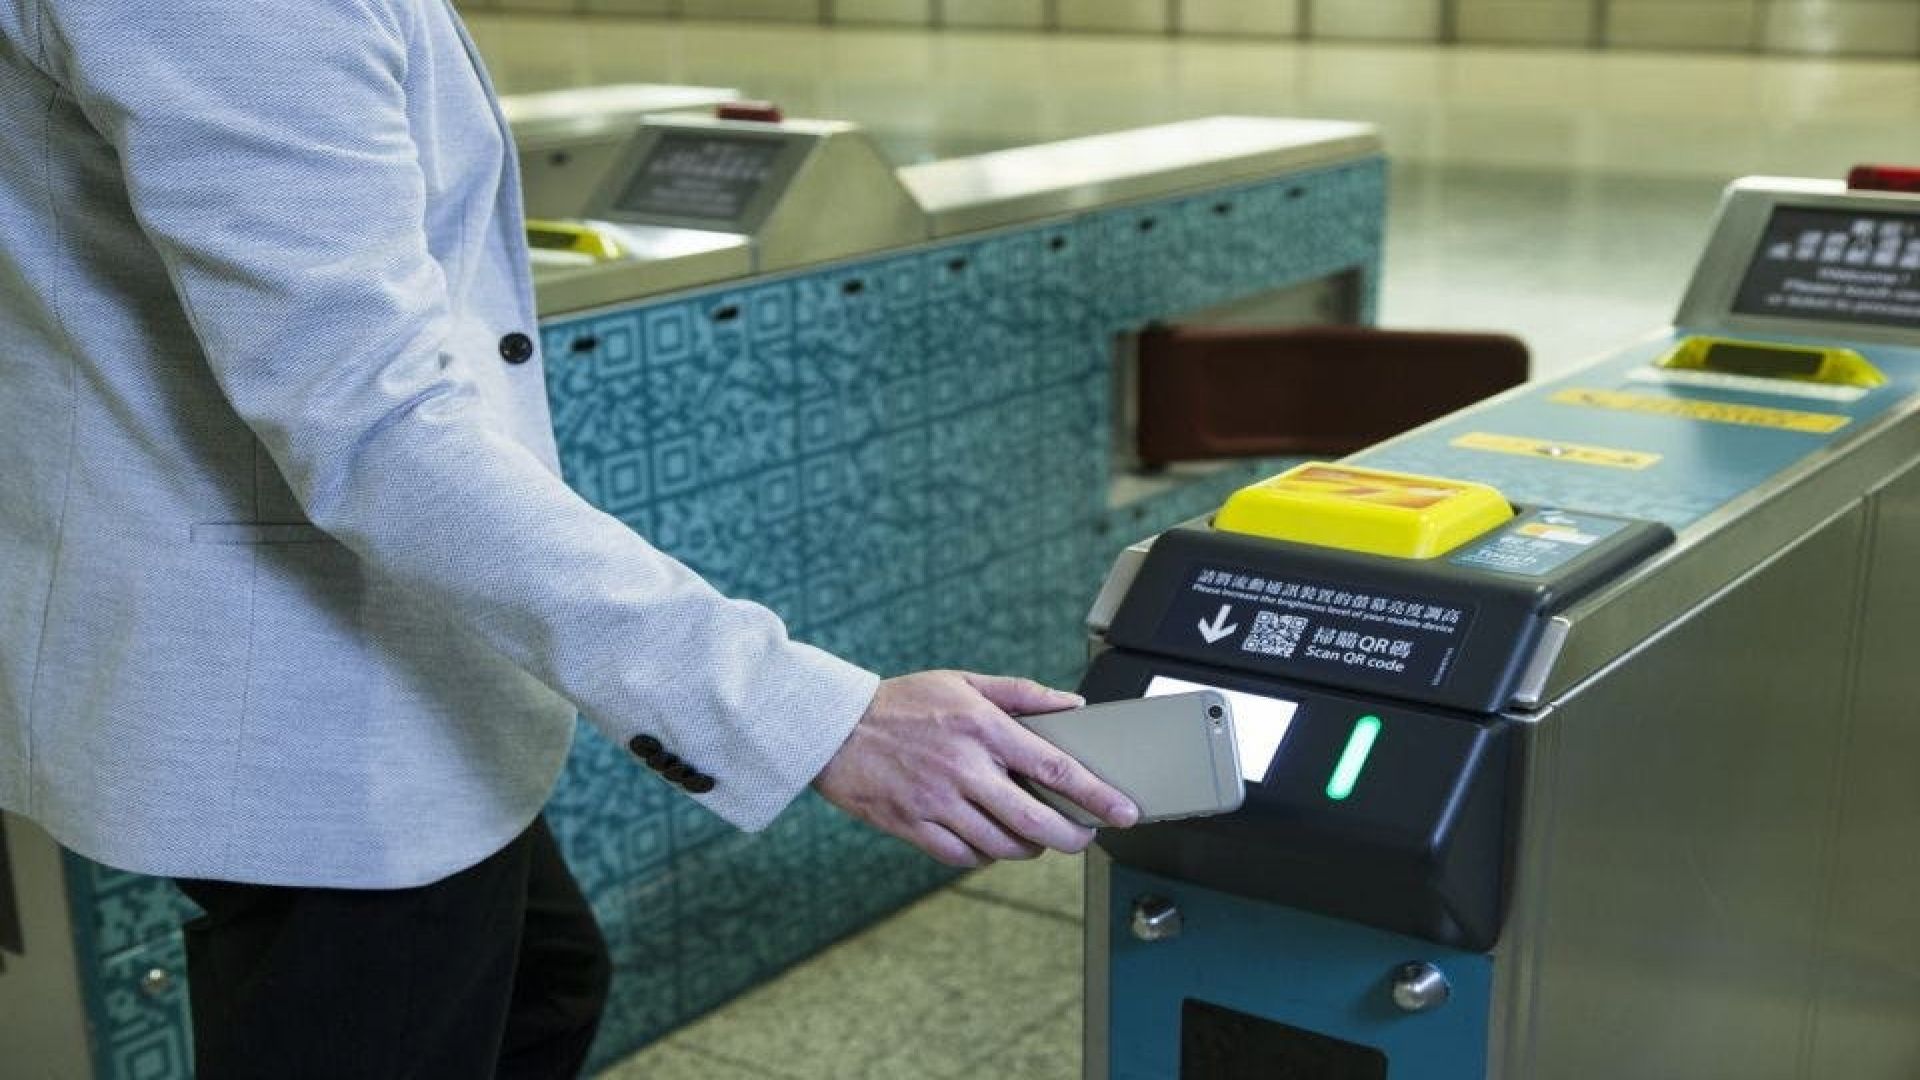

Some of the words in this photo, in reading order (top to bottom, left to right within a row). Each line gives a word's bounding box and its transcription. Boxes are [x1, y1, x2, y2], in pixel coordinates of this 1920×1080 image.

[1306, 645, 1340, 662] Scan
[1343, 652, 1367, 666] QR
[1367, 656, 1405, 673] code
